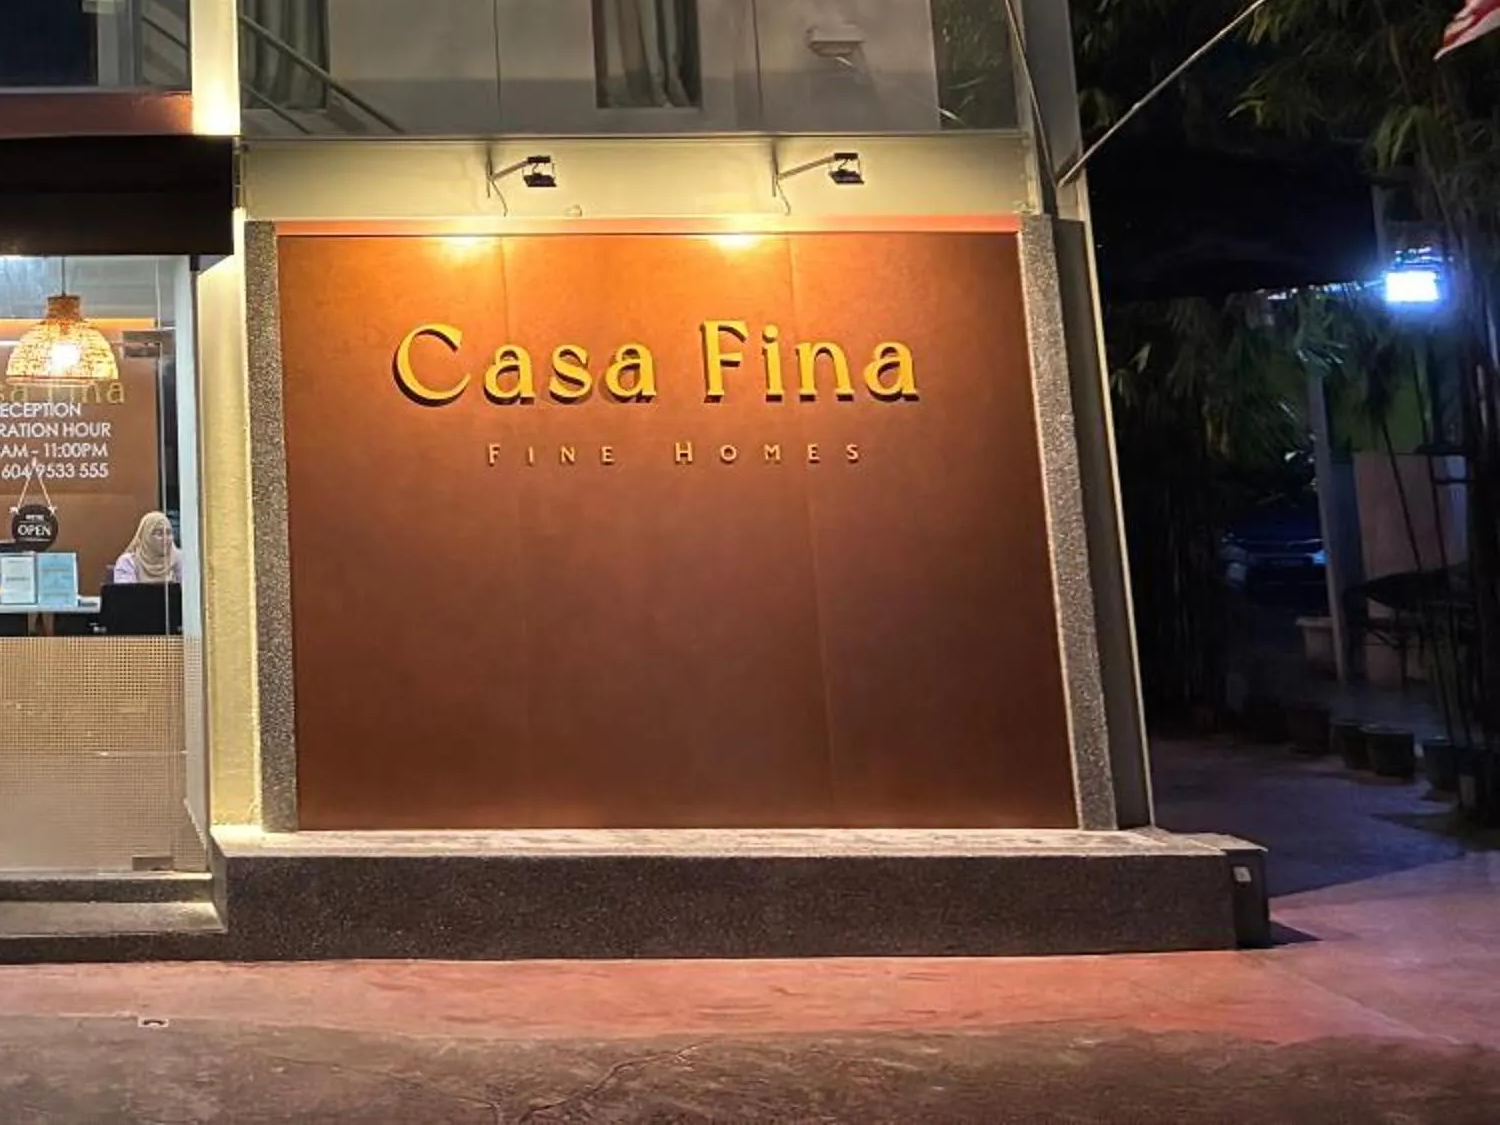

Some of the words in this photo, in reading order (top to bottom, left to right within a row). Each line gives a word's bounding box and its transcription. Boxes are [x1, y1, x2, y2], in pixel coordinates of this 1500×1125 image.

[393, 323, 657, 406] Casa
[700, 320, 919, 403] Fina
[62, 421, 111, 438] HOUR
[43, 441, 109, 458] 11:00PM
[488, 443, 616, 465] FINE
[674, 441, 862, 465] HOMES
[79, 461, 110, 478] 555
[17, 524, 51, 536] OPEN
